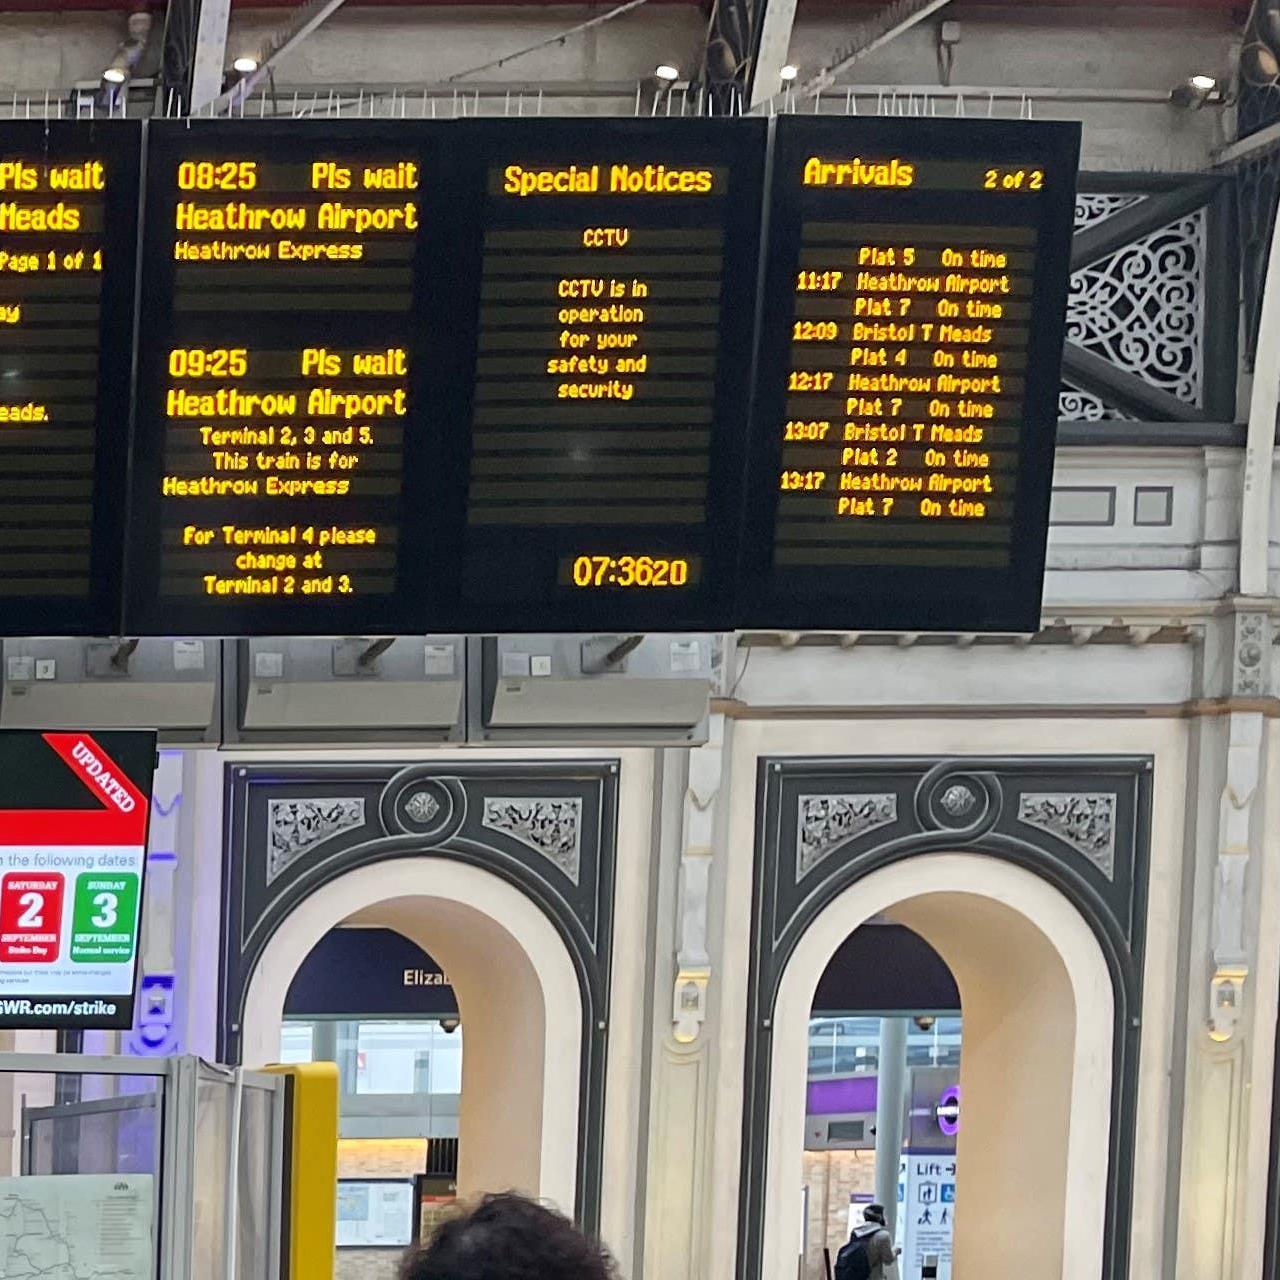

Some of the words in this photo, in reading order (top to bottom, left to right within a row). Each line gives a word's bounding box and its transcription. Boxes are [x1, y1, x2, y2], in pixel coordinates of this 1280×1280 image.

[45, 161, 104, 189] wait
[179, 162, 256, 189] 08:25
[312, 163, 351, 188] Pls
[363, 162, 418, 188] wait
[505, 166, 598, 196] Special
[611, 165, 712, 192] Notices
[804, 158, 913, 186] Arrivals
[985, 170, 997, 188] 2
[1003, 171, 1025, 188] of
[1030, 171, 1042, 188] 2
[0, 202, 79, 230] Meads
[176, 202, 306, 230] Heathrow
[318, 203, 418, 233] Airport
[584, 229, 628, 246] CCTV
[175, 241, 270, 260] Heathrow
[278, 241, 362, 260] Express
[858, 248, 895, 265] Plat
[903, 248, 915, 265] 5
[942, 249, 963, 267] On
[970, 250, 1007, 268] time
[559, 280, 603, 297] CCTV
[610, 281, 625, 297] is
[632, 280, 647, 297] in
[798, 272, 841, 290] 11:17
[856, 272, 941, 292] Heathrow
[944, 274, 1010, 294] Airport
[559, 305, 643, 324] operation
[855, 298, 893, 316] Plat
[899, 298, 911, 316] 7
[936, 299, 959, 317] On
[966, 300, 1002, 318] time
[560, 330, 590, 347] for
[597, 334, 637, 349] your
[794, 322, 837, 340] 12:09
[853, 323, 915, 341] Bristol
[922, 324, 933, 341] T
[939, 324, 991, 342] Meads
[547, 355, 608, 374] safety
[615, 355, 646, 372] and
[558, 381, 633, 400] security
[184, 526, 214, 545] For
[222, 526, 296, 544] Terminal
[302, 527, 314, 544] 4
[319, 527, 375, 546] please
[236, 552, 296, 571] change
[303, 551, 322, 568] at
[204, 576, 278, 594] Terminal
[284, 576, 295, 593] 2
[301, 576, 333, 594] and
[71, 741, 135, 813] UPDATED
[8, 852, 30, 866] the
[34, 852, 95, 869] following
[18, 892, 43, 927] 2
[91, 892, 117, 927] 3
[916, 1163, 942, 1176] Lift
